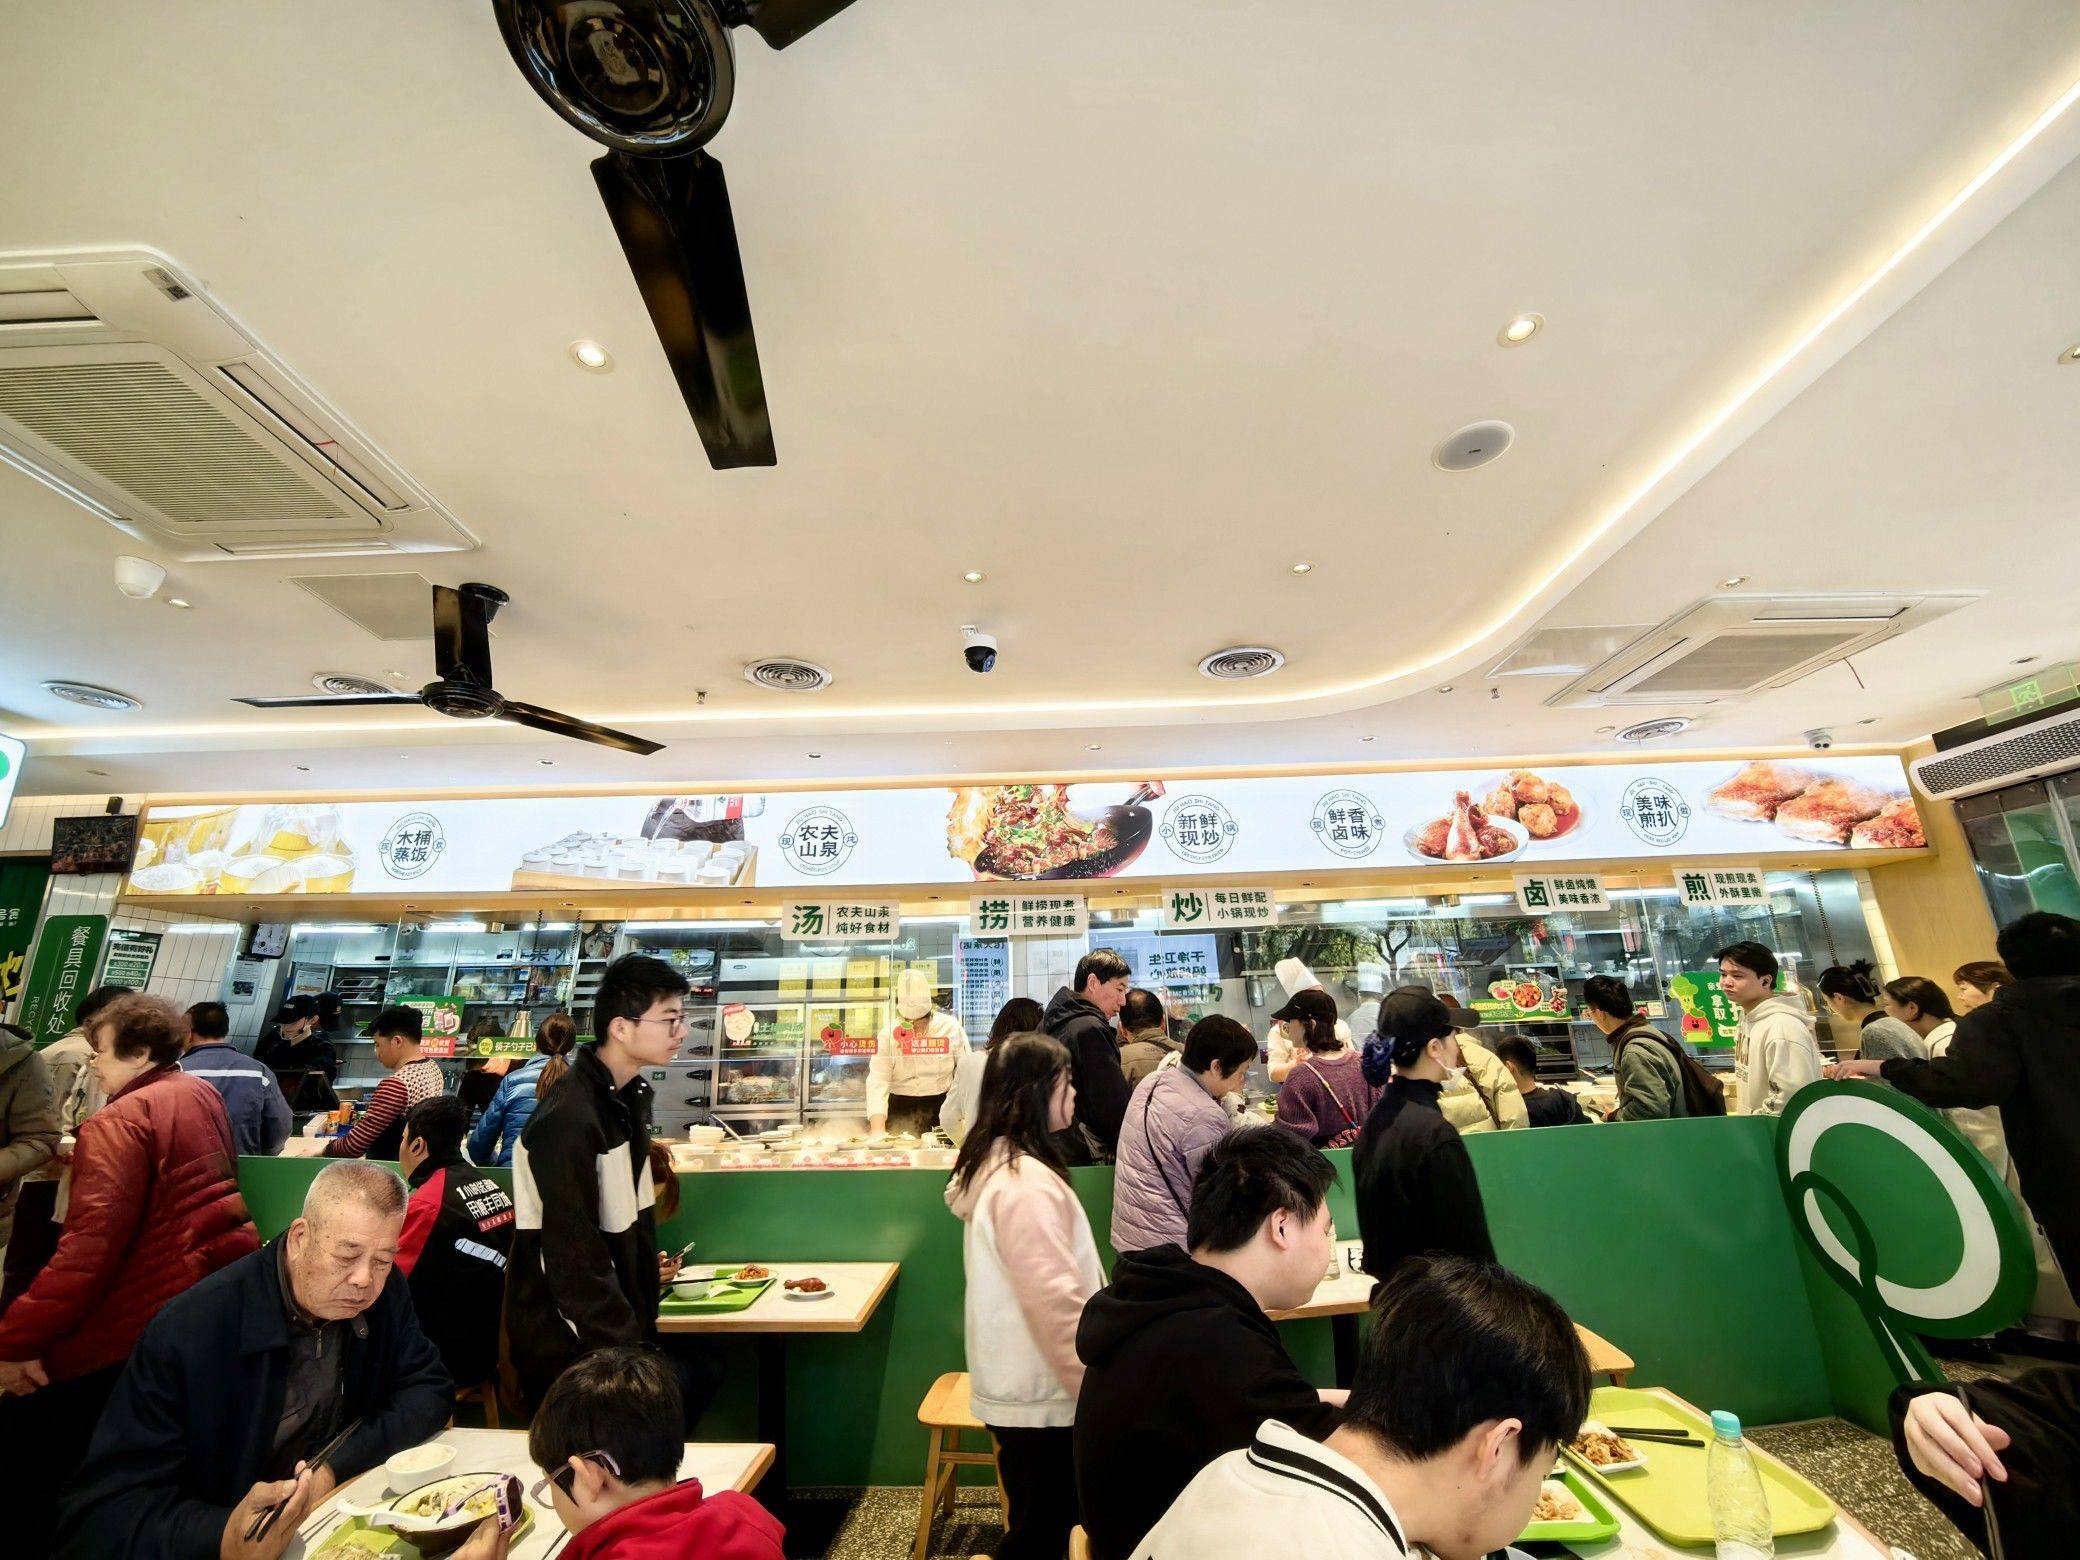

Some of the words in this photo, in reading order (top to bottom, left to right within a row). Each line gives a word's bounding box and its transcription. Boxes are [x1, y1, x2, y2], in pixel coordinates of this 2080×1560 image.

[1636, 794, 1672, 812] 美味
[1178, 812, 1218, 830] 新鲜
[1328, 808, 1365, 824] 鲜香
[1638, 810, 1676, 828] 煎扒
[396, 830, 432, 846] 木桶
[799, 824, 838, 842] 农夫
[1162, 826, 1172, 834] 小
[1179, 830, 1220, 846] 现炒
[1332, 824, 1370, 840] 卤味
[394, 846, 428, 862] 蒸饭
[800, 841, 839, 858] 山泉
[1714, 872, 1758, 884] 现煎现卖
[1524, 878, 1549, 907] 卤
[1682, 873, 1712, 901] 煎
[1720, 887, 1762, 898] 外酥里嫩
[1022, 900, 1076, 912] 鲜捞现煮
[1215, 892, 1268, 904] 每日鲜配
[1558, 893, 1601, 904] 美味香浓
[979, 900, 1010, 930] 捞
[1172, 892, 1202, 922] 炒
[1218, 907, 1269, 919] 小锅现炒
[792, 904, 824, 934] 汤
[1022, 915, 1076, 928] 营养健康
[836, 922, 890, 934] 炖好食材
[46, 926, 92, 1035] 餐具回收处
